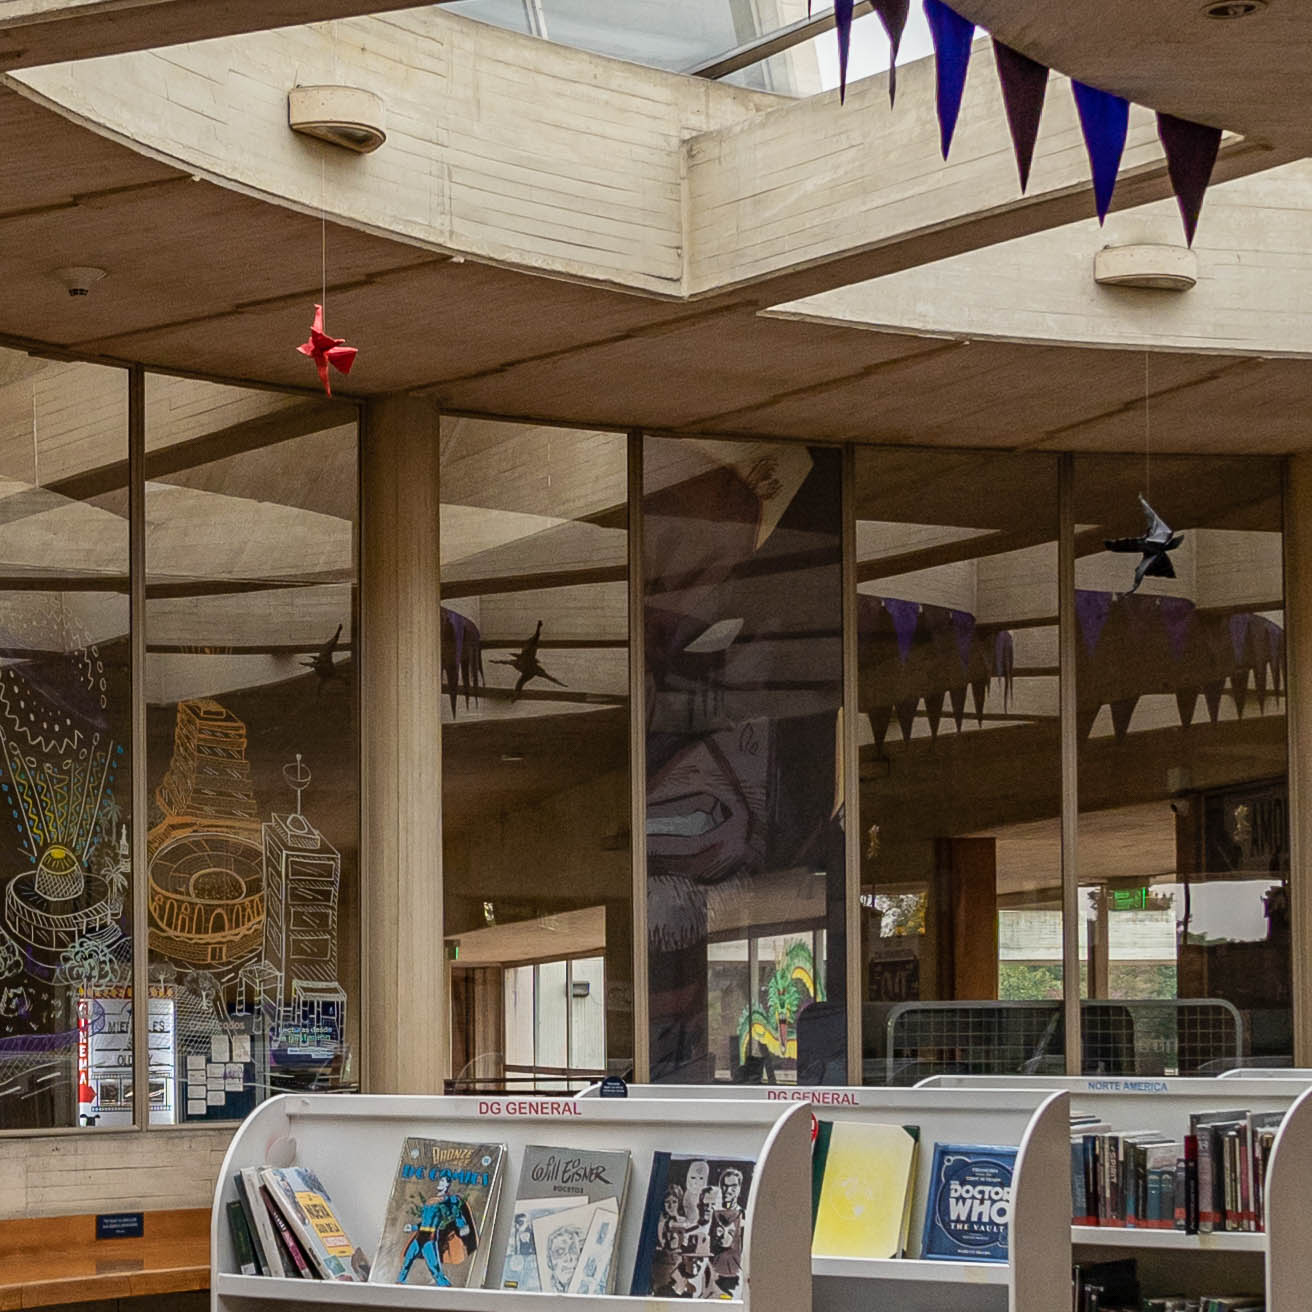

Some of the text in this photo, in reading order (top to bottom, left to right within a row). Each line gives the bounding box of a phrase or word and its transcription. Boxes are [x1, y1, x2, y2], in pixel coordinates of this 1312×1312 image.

[78, 1002, 88, 1085] CINEMA
[1088, 1081, 1167, 1091] NORTE AMERICA
[767, 1090, 859, 1105] DG GENERAL
[479, 1101, 582, 1115] DG GENERAL
[401, 1163, 425, 1180] DC
[949, 1198, 1009, 1224] WHO
[950, 1222, 1005, 1233] THE VAULT
